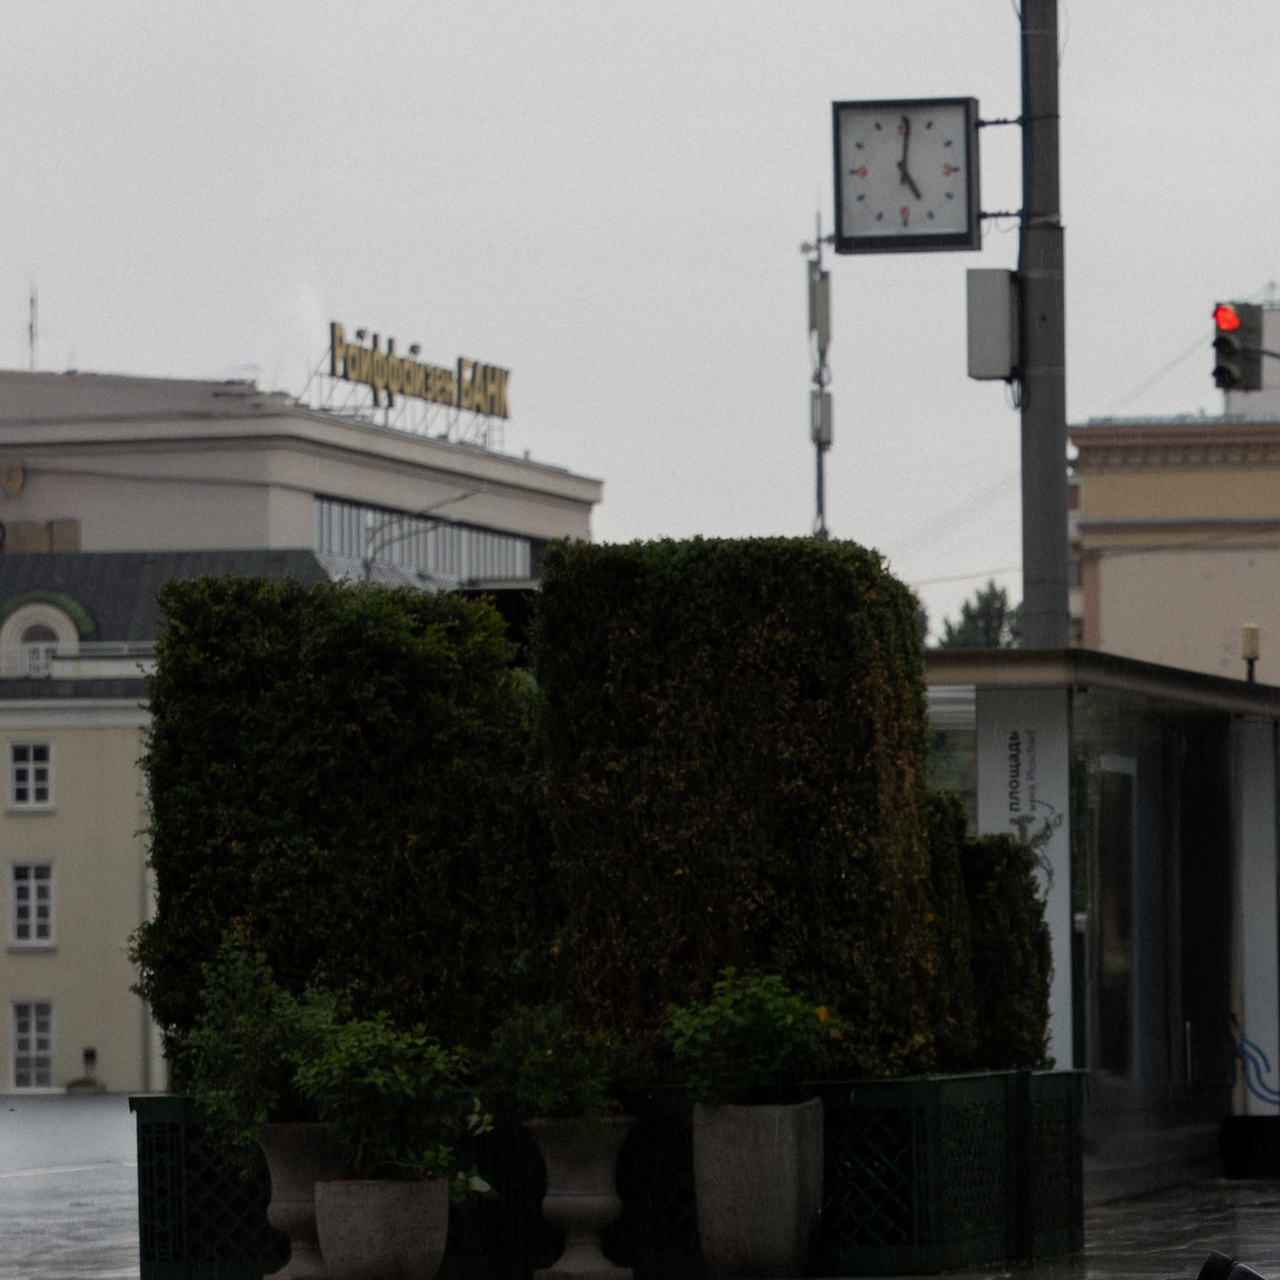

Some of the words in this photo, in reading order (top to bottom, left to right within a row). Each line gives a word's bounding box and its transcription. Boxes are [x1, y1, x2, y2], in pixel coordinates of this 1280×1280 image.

[330, 322, 453, 407] Райффайзен
[458, 357, 509, 418] БАНК
[1008, 729, 1022, 813] площадь
